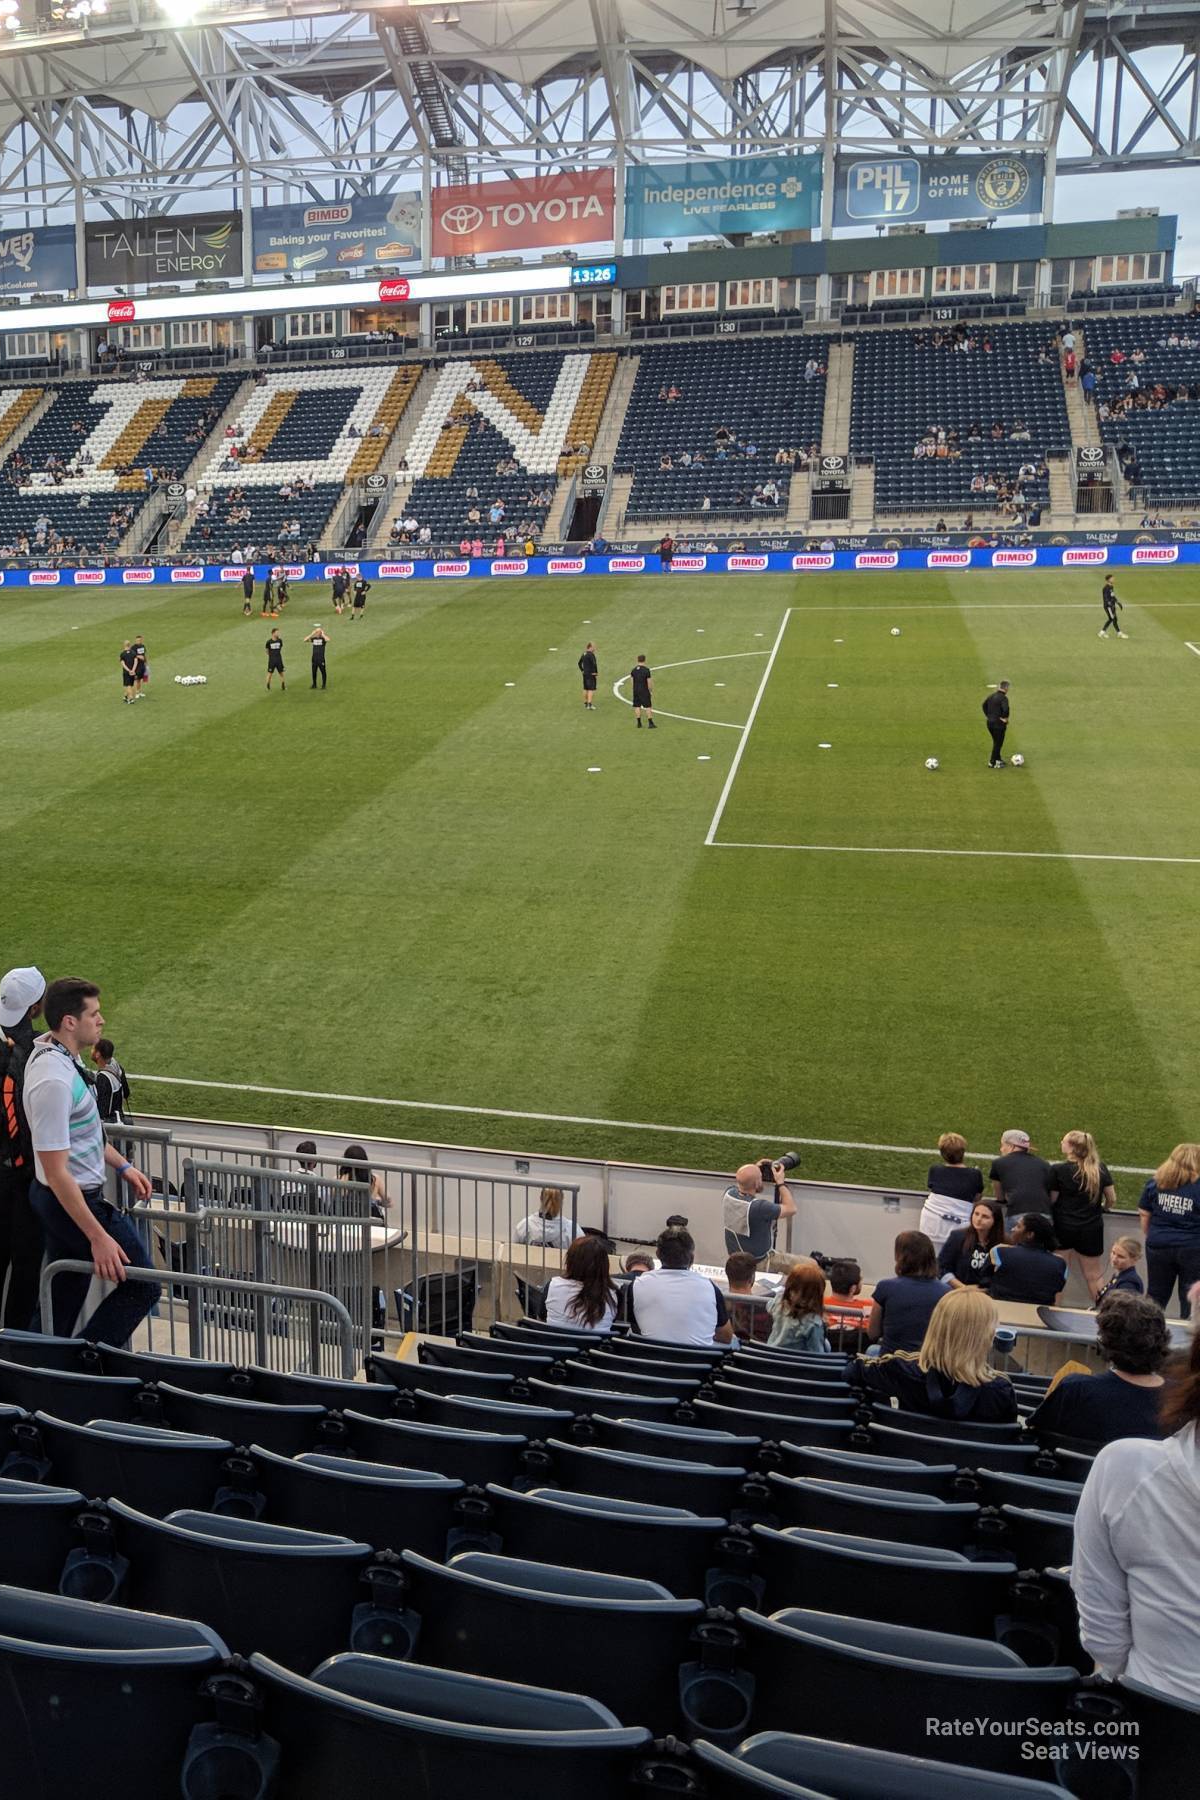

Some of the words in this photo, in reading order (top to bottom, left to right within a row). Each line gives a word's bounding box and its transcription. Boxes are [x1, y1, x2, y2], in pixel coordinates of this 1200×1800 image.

[856, 165, 911, 191] PHL
[928, 174, 969, 187] HOME
[643, 182, 777, 205] Independence
[928, 188, 944, 198] OF
[947, 186, 969, 197] THE
[882, 187, 911, 211] 17
[486, 195, 604, 228] TOYOTA
[683, 204, 712, 215] LIVE
[712, 201, 777, 213] FEARLESS
[307, 207, 350, 222] BIMBO
[269, 234, 305, 247] Baking
[307, 231, 332, 244] your
[333, 226, 387, 240] Favorites!
[94, 227, 196, 259] TALEN
[155, 254, 227, 273] ENERGY
[573, 268, 611, 284] 13:26
[936, 310, 952, 319] 131
[719, 323, 735, 333] 130
[517, 337, 533, 346] 129
[331, 350, 345, 358] 128
[139, 362, 152, 371] 127
[858, 555, 896, 565] BIMBO
[930, 553, 968, 565] BIMBO
[995, 552, 1033, 564] BIMBO
[1065, 551, 1105, 561] BIMBO
[1135, 549, 1175, 560] BIMBO
[493, 562, 525, 572] BIMBO
[550, 561, 583, 571] BIMBO
[611, 560, 643, 569] BIMBO
[730, 557, 765, 568] BIMBO
[795, 556, 832, 567] BIMBO
[381, 565, 412, 575] BIMBO
[436, 563, 467, 574] BIMBO
[31, 573, 57, 582] BIMBO
[76, 572, 103, 582] BIMBO
[124, 571, 152, 581] BIMBO
[173, 570, 201, 579] BIMBO
[1157, 1193, 1194, 1212] WHEELER
